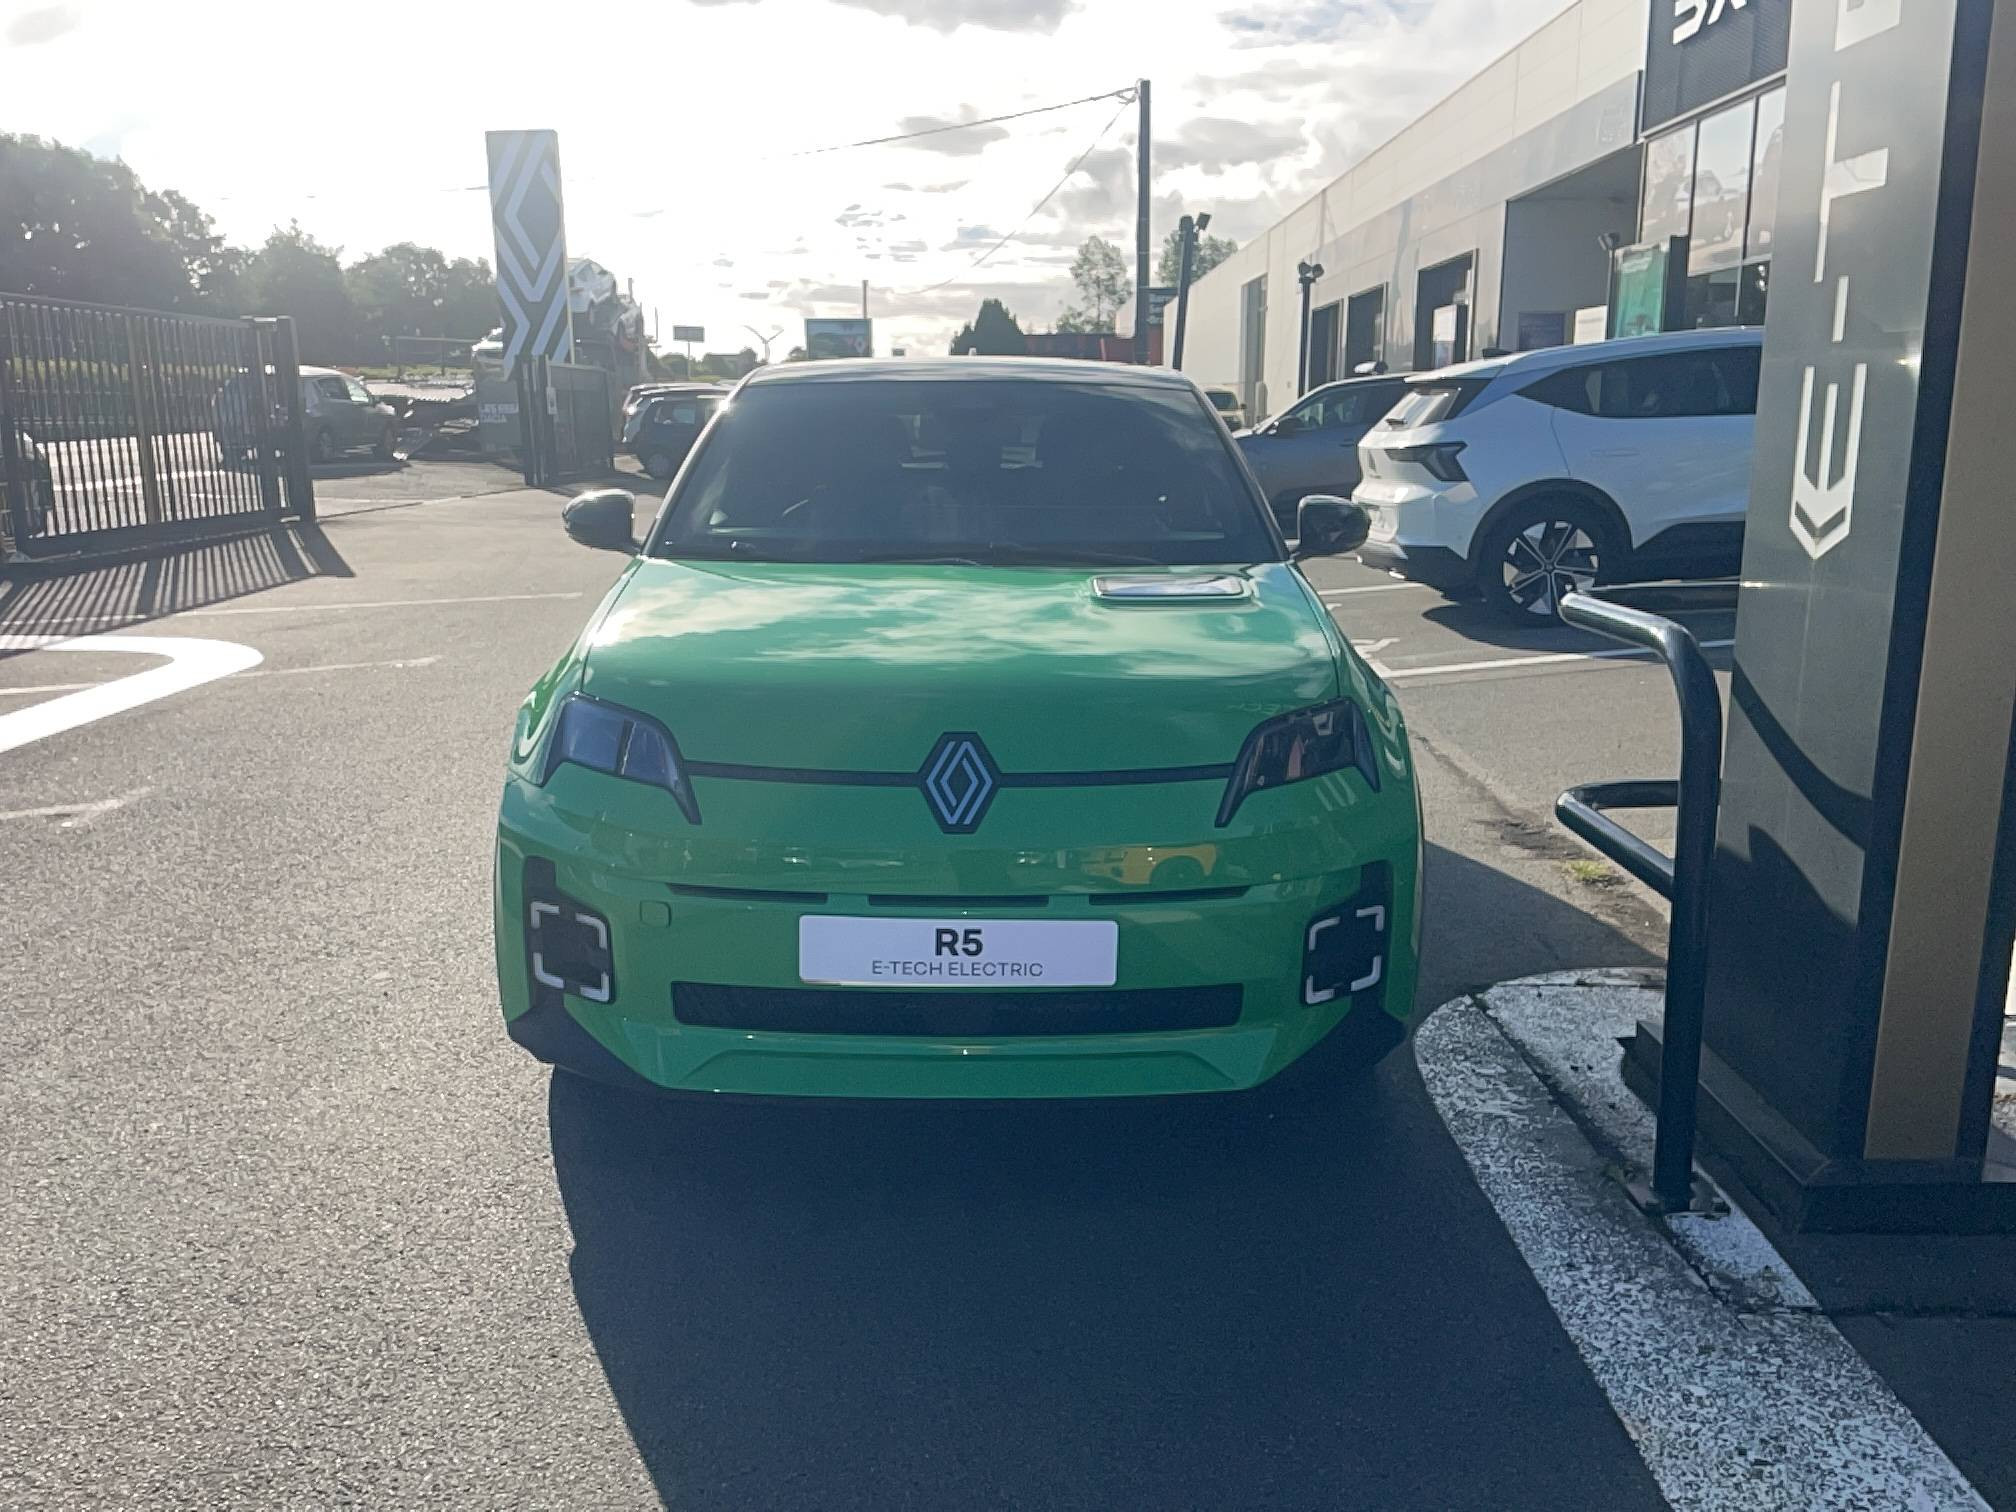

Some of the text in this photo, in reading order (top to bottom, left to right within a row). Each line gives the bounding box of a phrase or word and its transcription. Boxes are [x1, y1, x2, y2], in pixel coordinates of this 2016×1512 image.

[935, 928, 984, 957] R5
[872, 960, 1043, 977] E-TECH ELECTRIC
